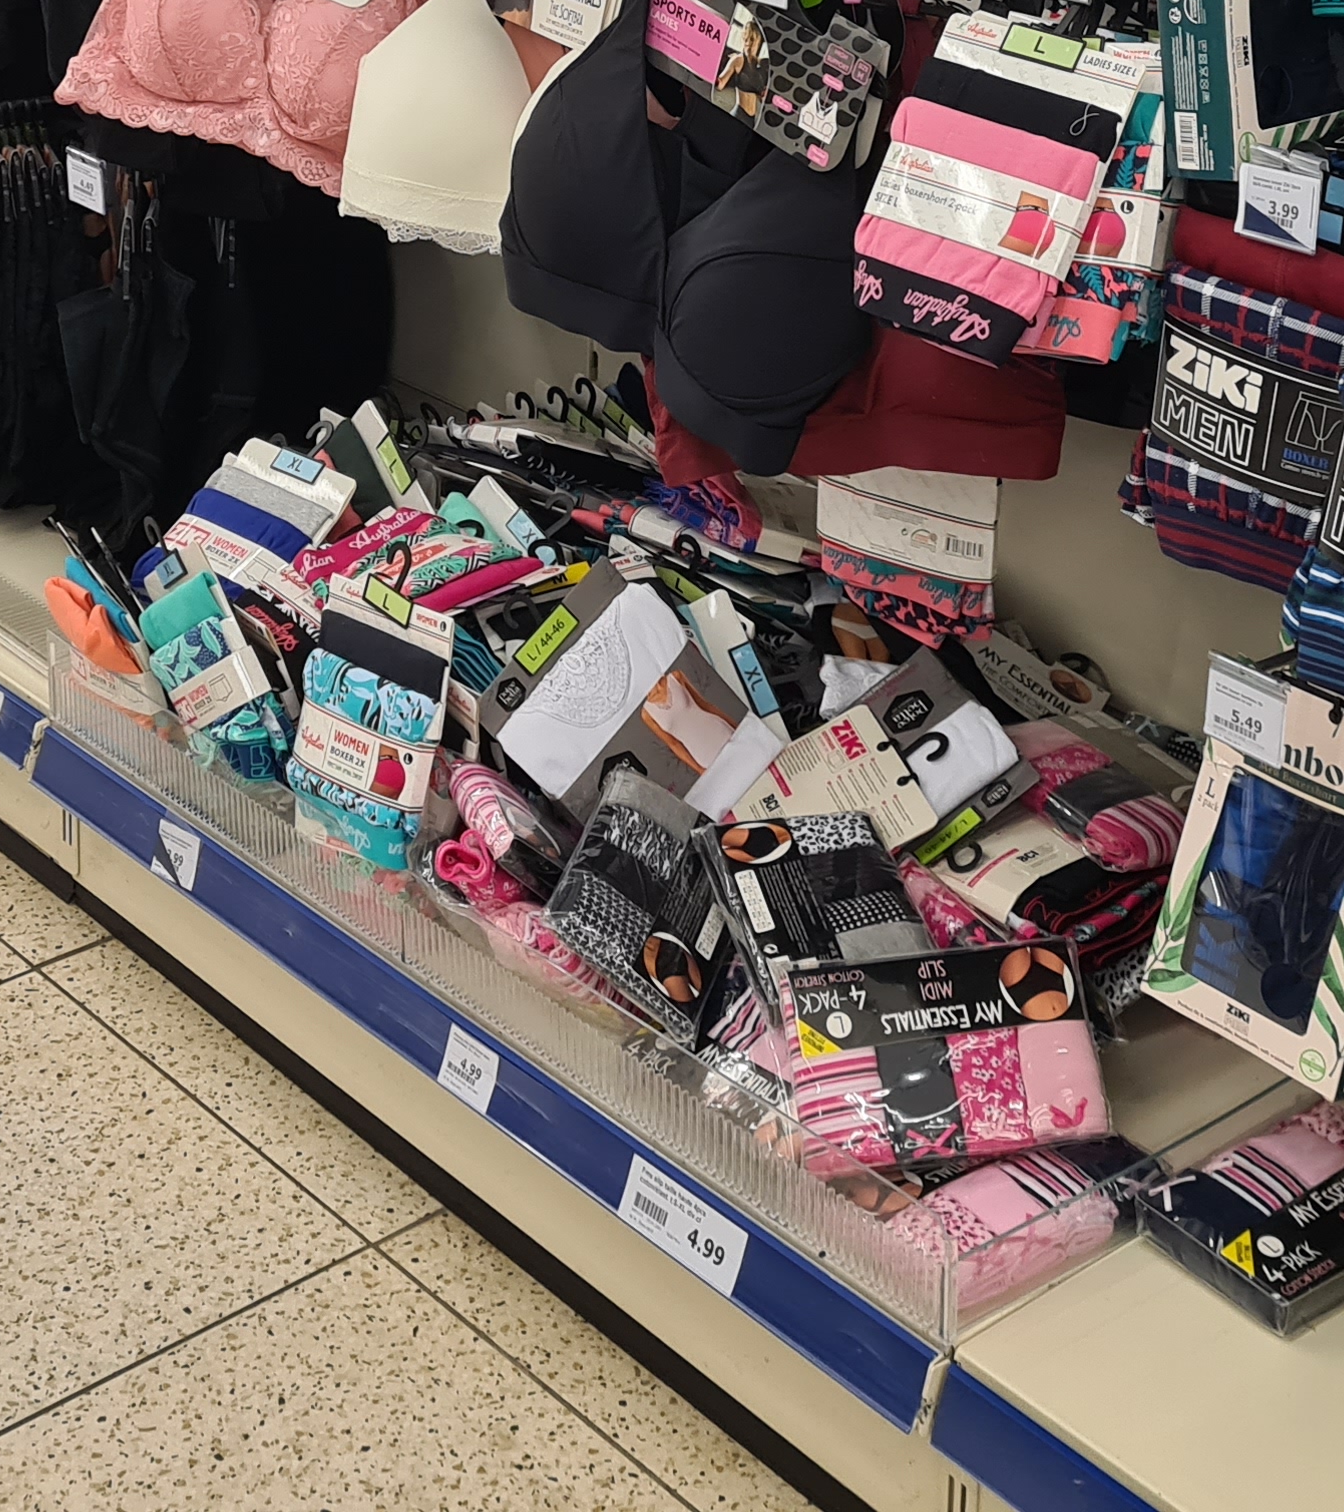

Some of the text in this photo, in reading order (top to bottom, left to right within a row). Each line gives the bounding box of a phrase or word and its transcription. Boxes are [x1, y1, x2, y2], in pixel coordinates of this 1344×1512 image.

[651, 8, 680, 32] LADIES
[698, 18, 722, 44] BRA
[1034, 35, 1045, 54] L
[903, 181, 947, 211] boxershort
[1159, 384, 1254, 467] MEN
[286, 456, 303, 473] XL
[388, 459, 397, 474] L
[204, 544, 239, 563] BOXER 2X
[212, 534, 249, 558] WOMEN
[382, 593, 390, 611] L
[743, 666, 764, 692] XL
[1231, 708, 1263, 735] 5.49
[333, 729, 370, 757] WOMEN
[329, 746, 366, 769] BOXER 2X
[1205, 776, 1216, 799] L
[761, 793, 781, 813] BCI
[918, 958, 948, 980] SLIP
[799, 984, 867, 1016] 4-PACK
[919, 979, 953, 1001] MIDI
[880, 999, 1004, 1036] MY ESSENTIALS
[460, 1057, 483, 1081] 4.99
[1288, 1198, 1321, 1228] MY
[686, 1229, 726, 1267] 4.99
[1260, 1239, 1323, 1285] 4-PACK
